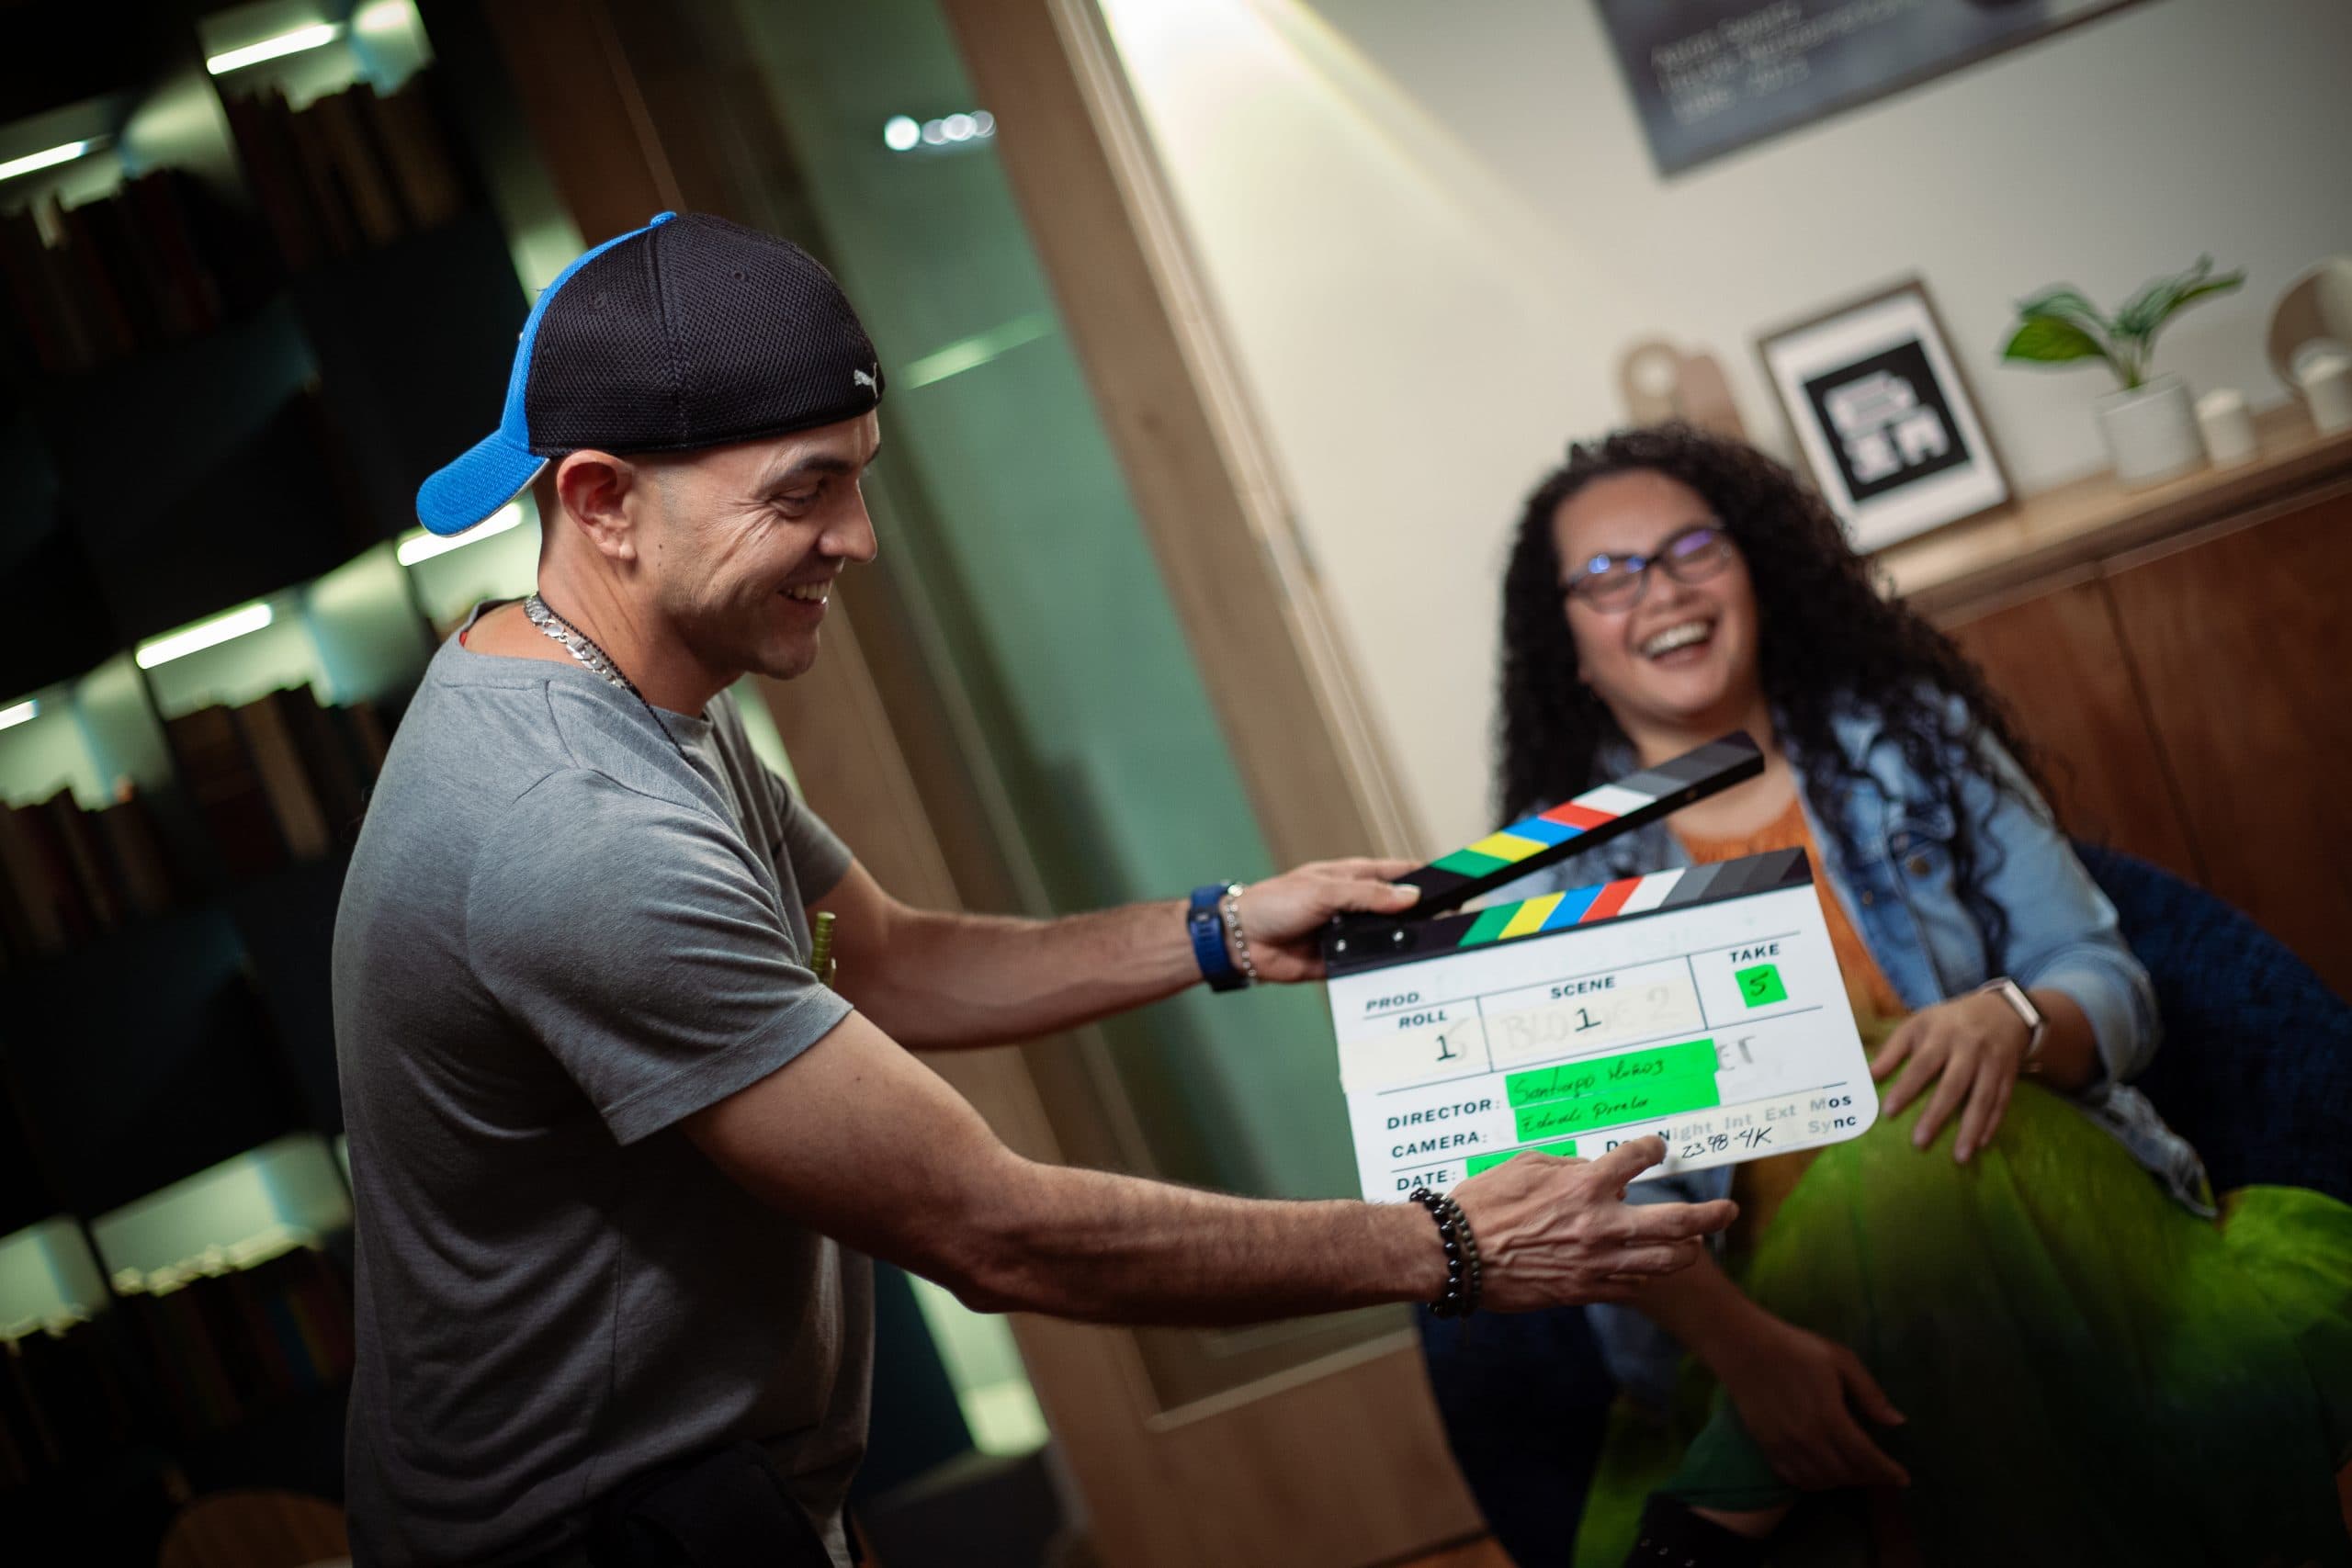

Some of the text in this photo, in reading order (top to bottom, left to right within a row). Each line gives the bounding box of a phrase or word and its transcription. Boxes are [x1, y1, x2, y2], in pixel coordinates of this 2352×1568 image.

[1730, 943, 1780, 963] TAKE
[1550, 976, 1616, 999] SCENE
[1749, 970, 1770, 997] 5
[1398, 1010, 1448, 1029] ROLL
[1575, 1008, 1601, 1032] 1
[1436, 1033, 1456, 1062] 1
[1386, 1099, 1500, 1130] DIRECTOR:
[1724, 1113, 1752, 1129] Int
[1765, 1104, 1797, 1122] Ext
[1810, 1094, 1852, 1112] Mos
[1807, 1115, 1857, 1135] Sync
[1392, 1131, 1488, 1158] CAMERA:
[1396, 1170, 1456, 1190] DATE:
